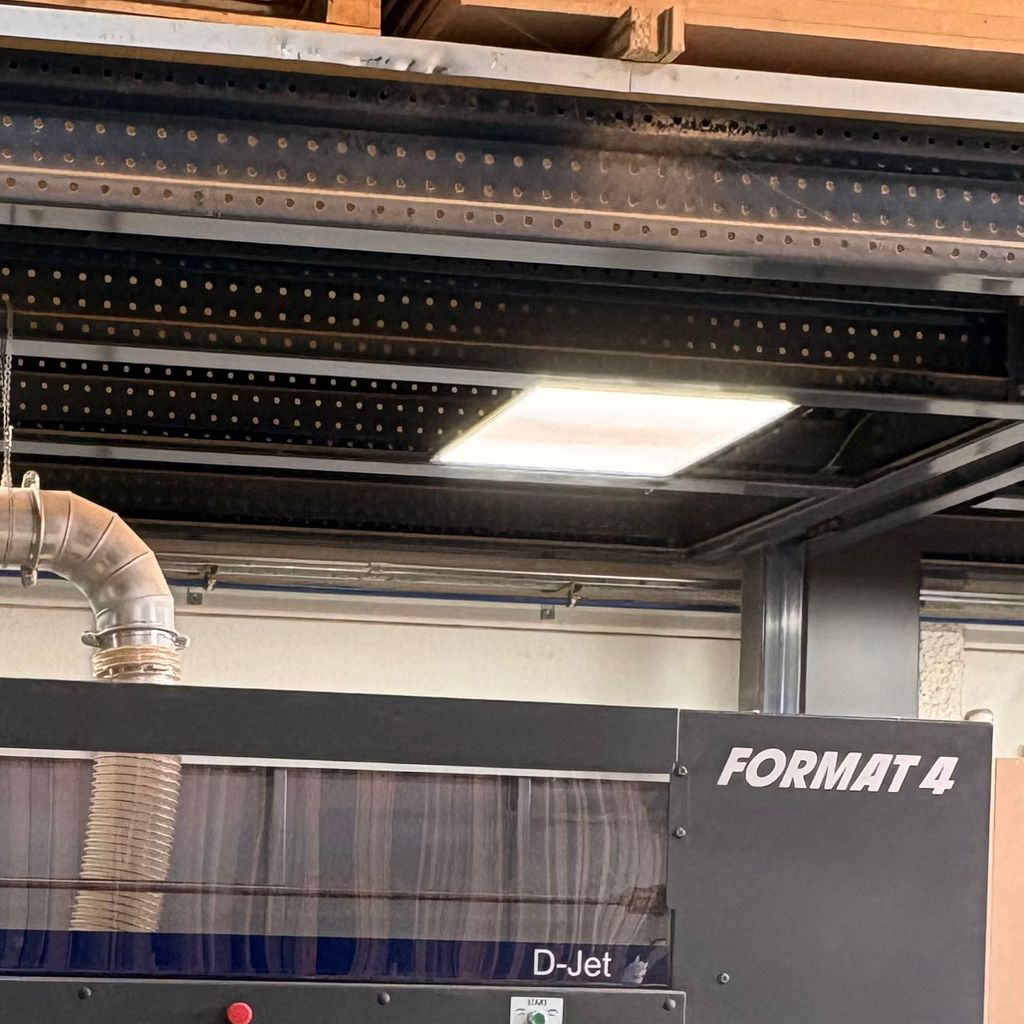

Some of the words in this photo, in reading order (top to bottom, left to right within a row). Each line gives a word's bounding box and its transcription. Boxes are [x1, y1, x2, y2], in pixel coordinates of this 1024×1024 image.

[716, 747, 922, 793] FORMAT
[918, 756, 959, 795] 4
[533, 948, 612, 978] D-Jet
